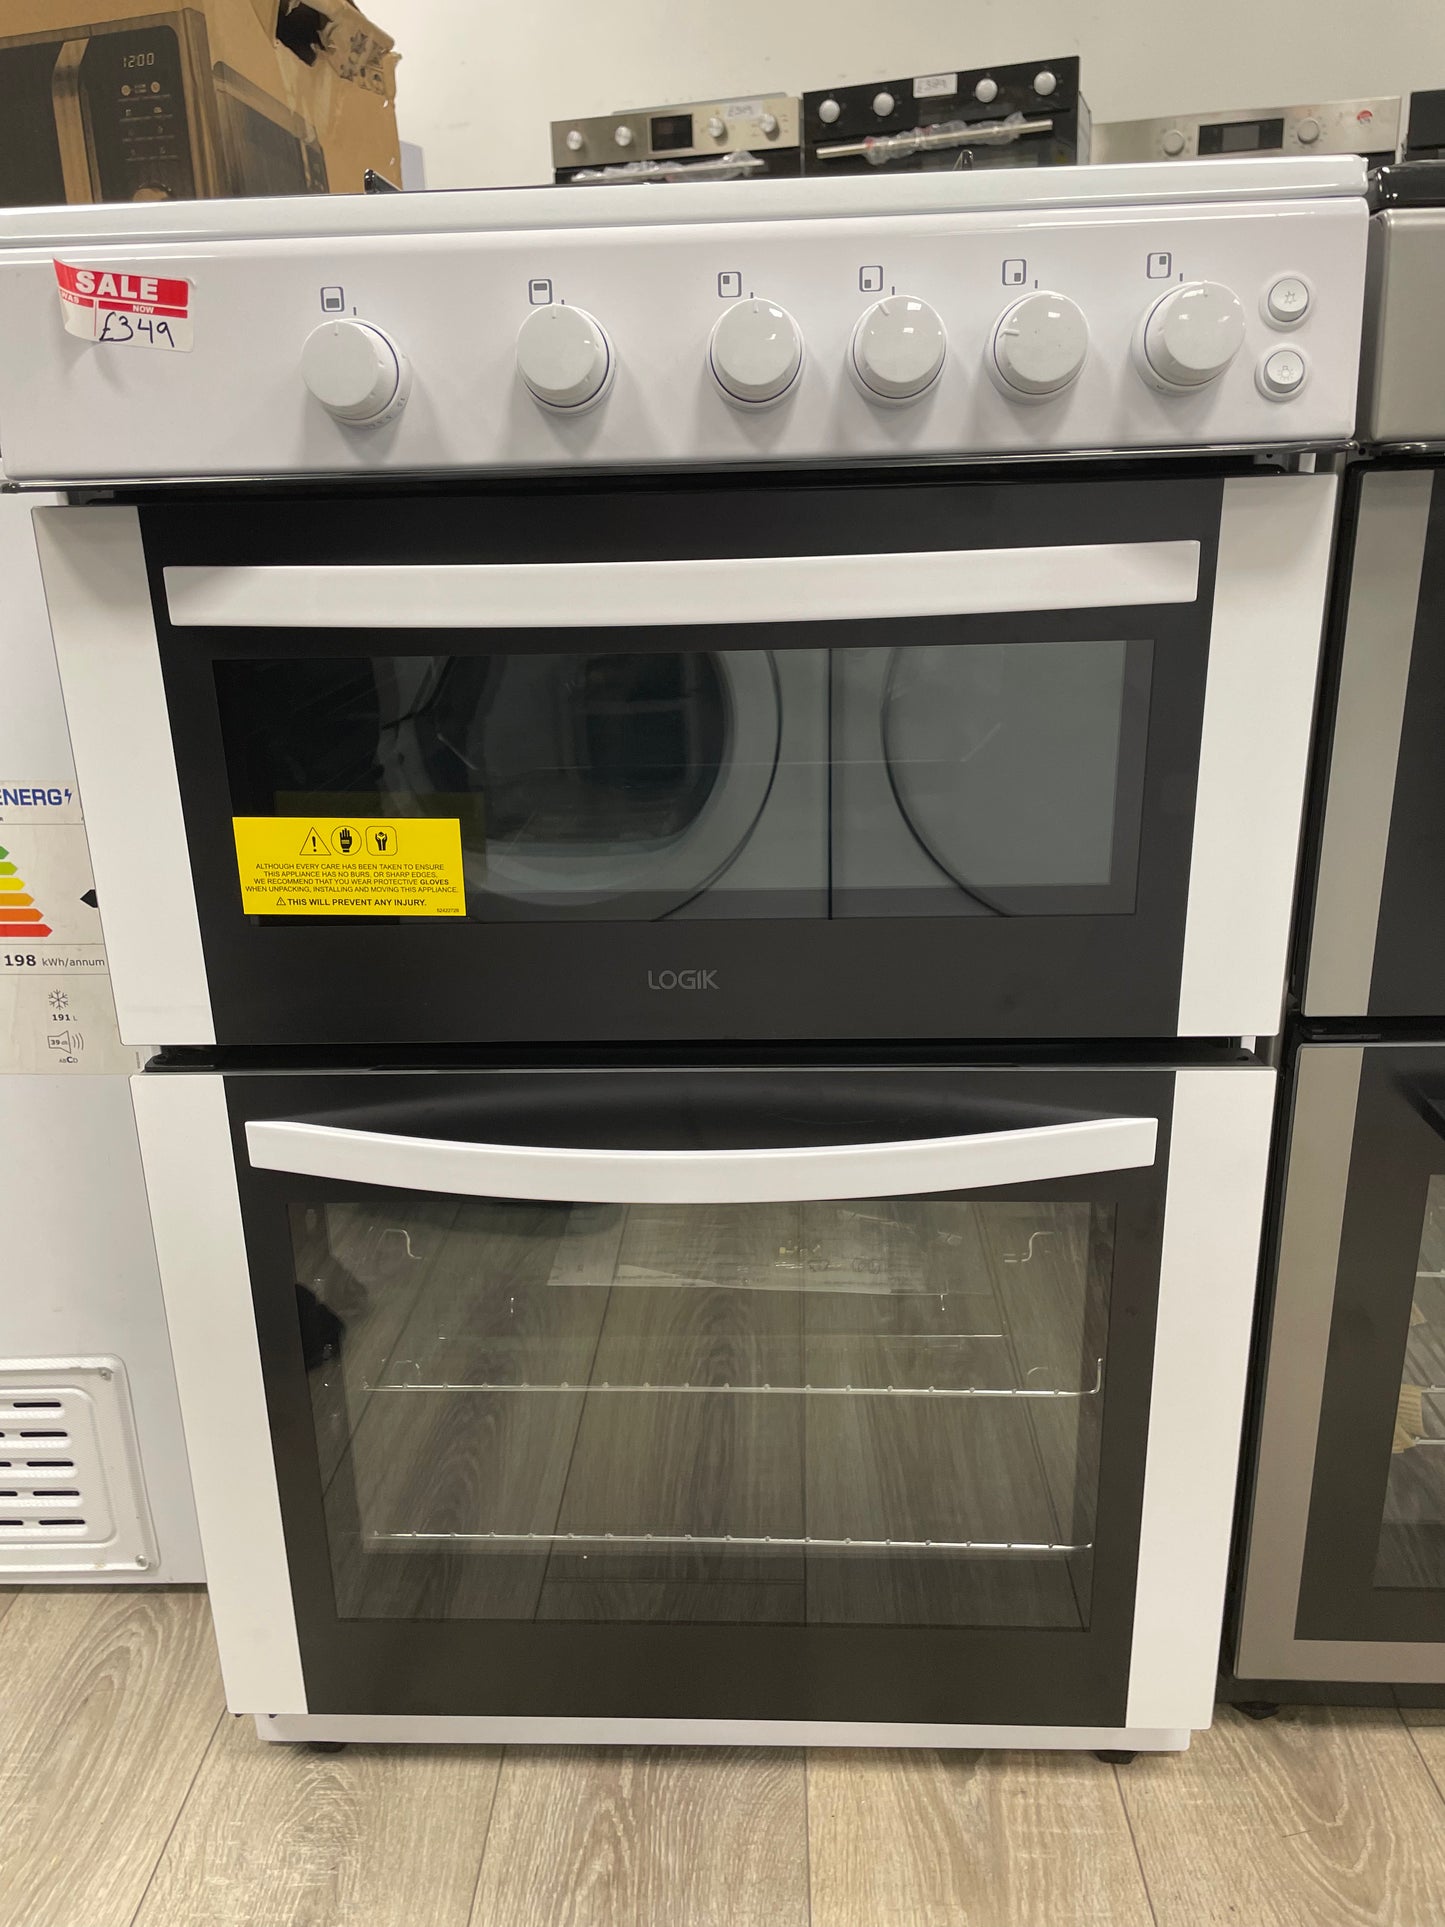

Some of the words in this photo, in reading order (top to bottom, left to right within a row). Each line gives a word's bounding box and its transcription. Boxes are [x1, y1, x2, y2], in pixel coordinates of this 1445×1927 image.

[123, 53, 155, 68] 1200
[75, 270, 158, 302] SALE
[61, 292, 80, 304] WAS
[132, 304, 155, 315] NOW
[98, 311, 175, 348] £349
[0, 788, 63, 806] NERG
[287, 898, 307, 906] THIS
[308, 898, 330, 906] WILL
[332, 898, 372, 906] PREVENT
[373, 899, 392, 907] ANY
[394, 899, 427, 907] INJURY.
[4, 954, 37, 967] 198
[41, 957, 105, 968] kWh/annum
[647, 969, 720, 990] LOGIK
[52, 1013, 71, 1021] 191
